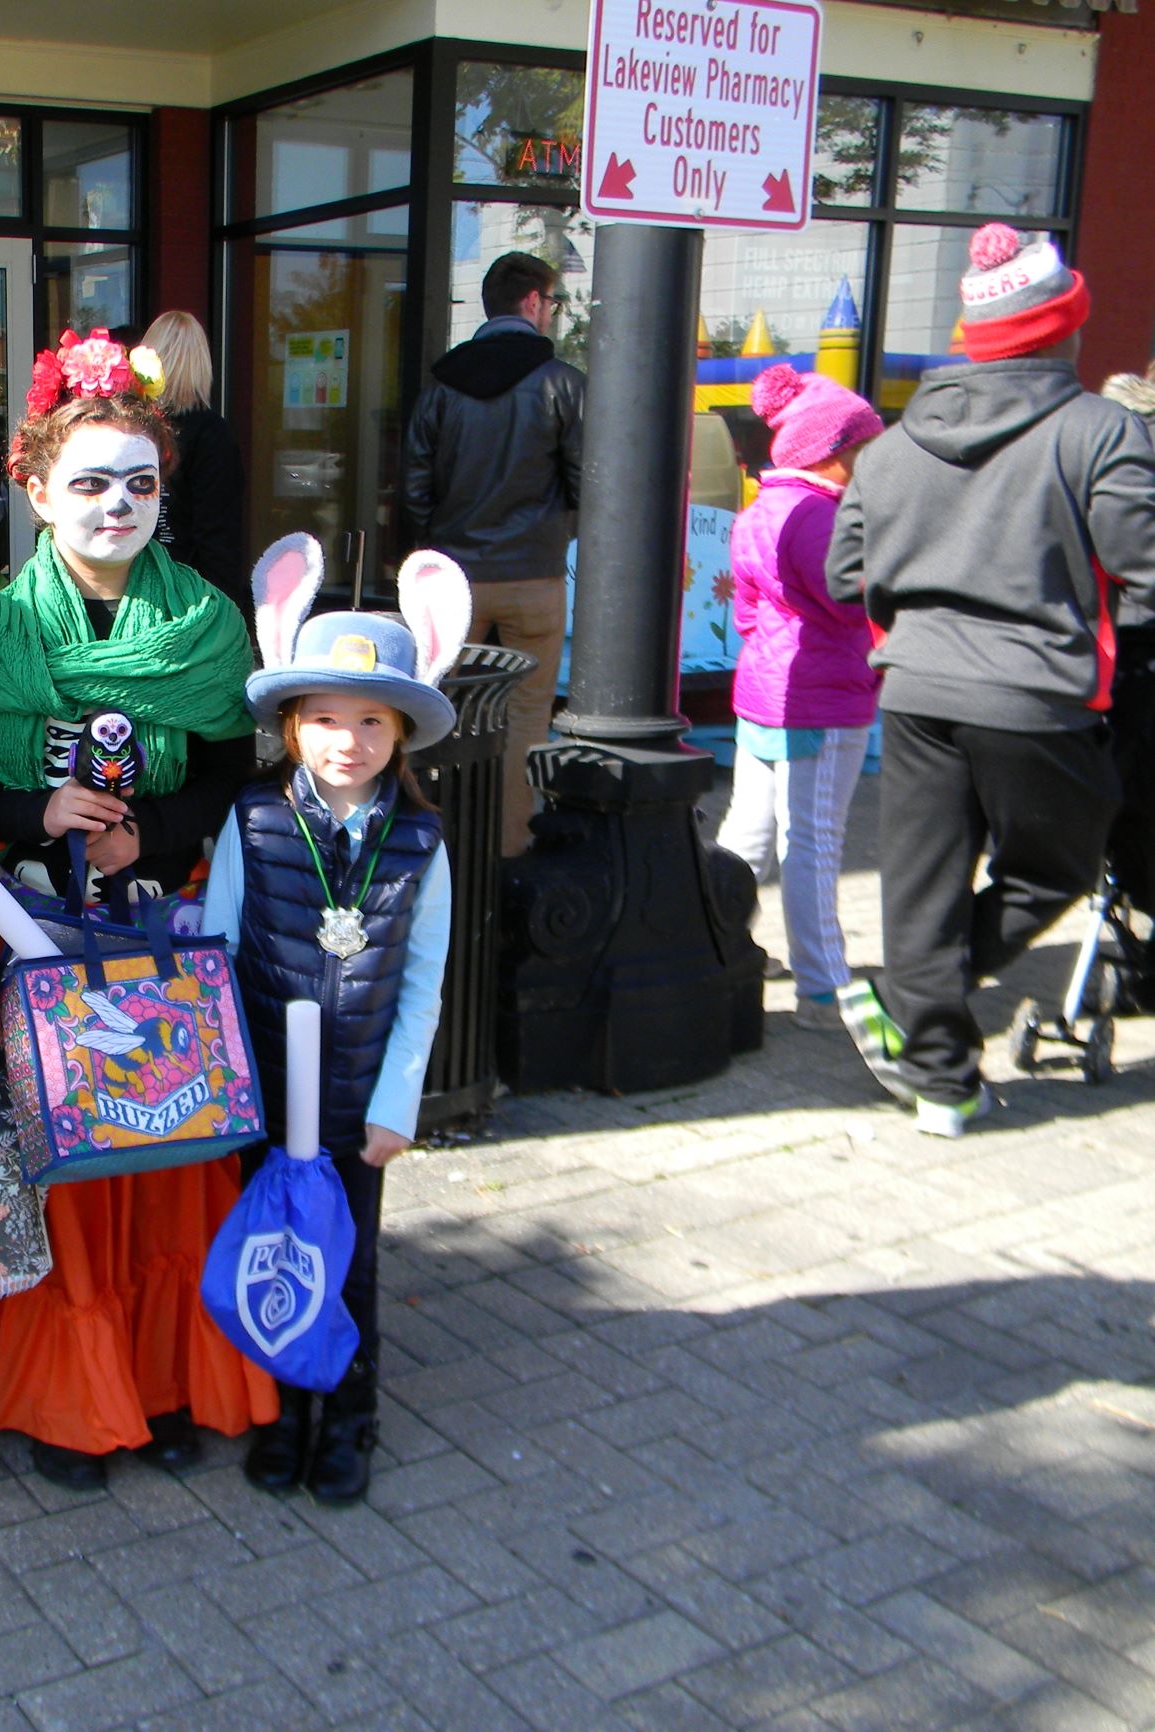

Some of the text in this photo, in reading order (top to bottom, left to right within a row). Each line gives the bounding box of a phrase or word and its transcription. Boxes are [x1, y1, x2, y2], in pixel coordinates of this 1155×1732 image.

[635, 0, 782, 55] Reserved for
[602, 43, 805, 121] Lakeview Pharmacy
[643, 102, 761, 156] Customers
[517, 138, 580, 176] ATM
[672, 155, 727, 211] Only
[690, 508, 717, 536] kind
[98, 1081, 207, 1133] BUZZED
